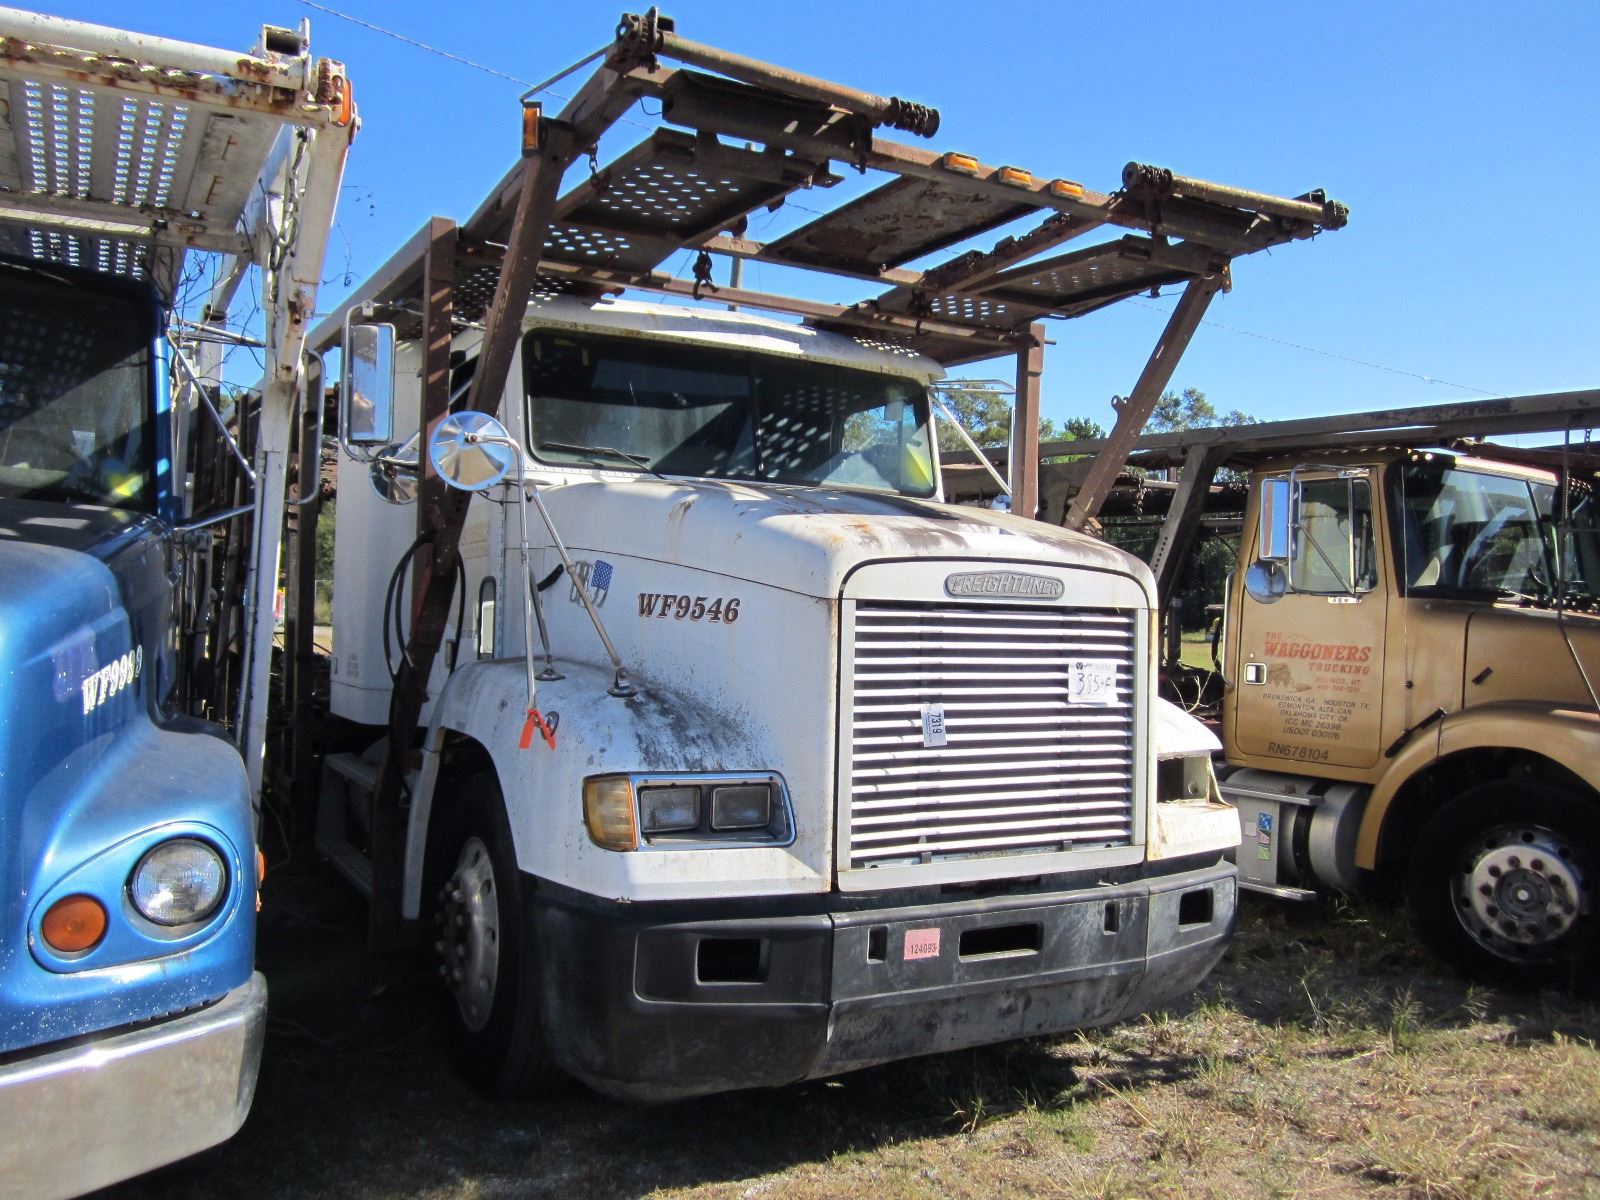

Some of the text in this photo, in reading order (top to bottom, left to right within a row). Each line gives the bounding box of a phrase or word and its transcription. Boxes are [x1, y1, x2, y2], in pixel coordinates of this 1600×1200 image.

[951, 574, 1060, 595] FREIGHTLINER
[638, 593, 741, 624] WF9546
[1264, 632, 1282, 640] THE
[1264, 641, 1371, 661] WAGGONERS
[1308, 662, 1370, 676] TRUCKING
[930, 712, 943, 734] 7319
[1301, 720, 1313, 728] MC
[1283, 727, 1309, 736] USDOT
[1268, 742, 1329, 760] RN678104
[911, 943, 937, 954] 124093
